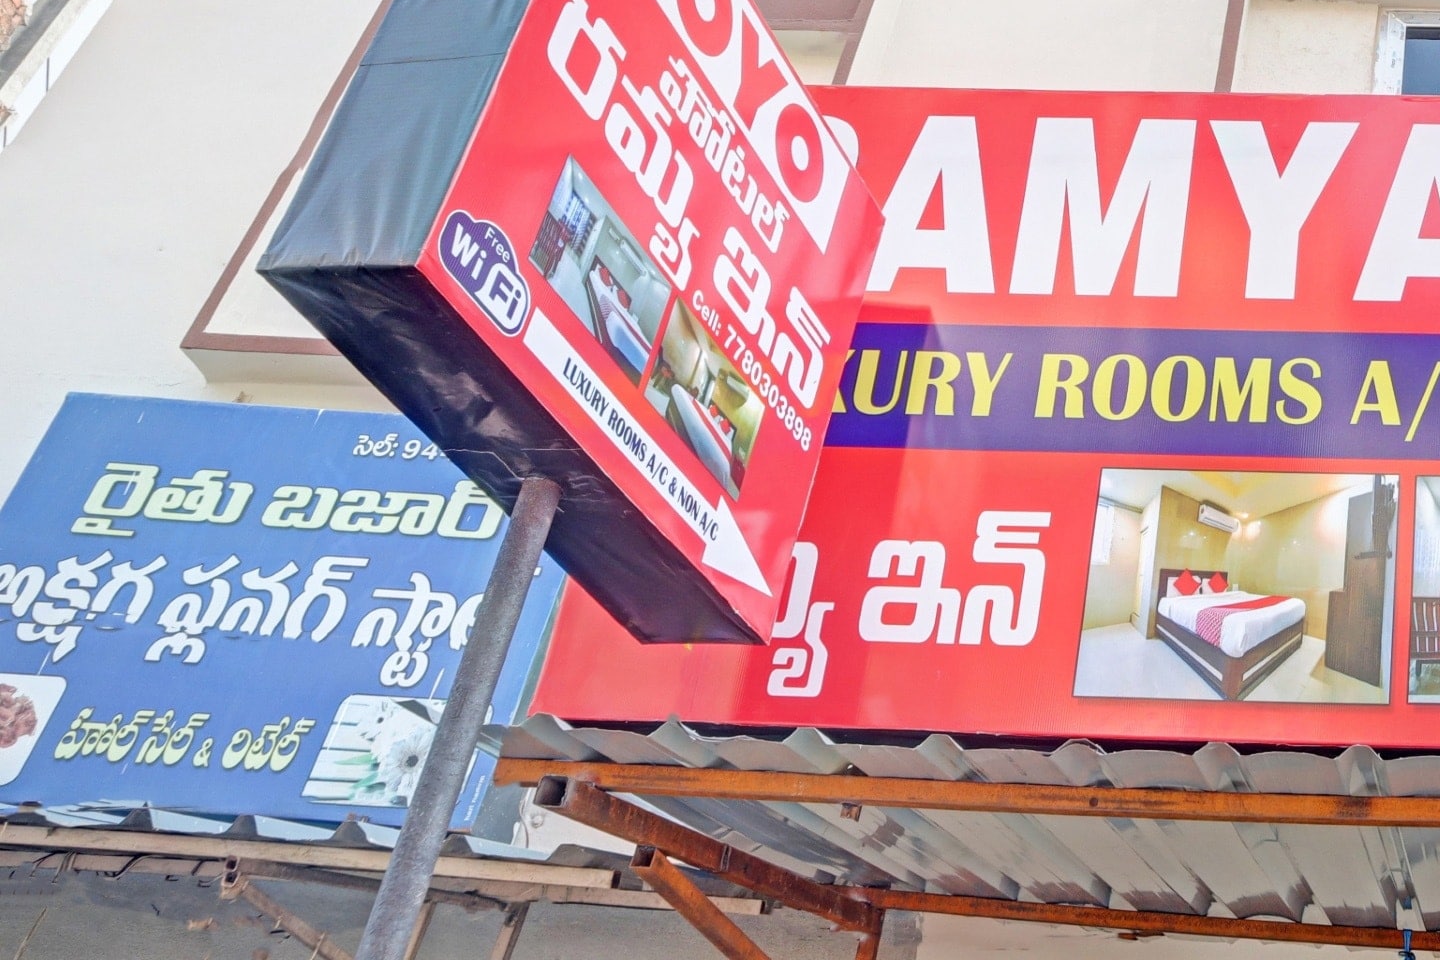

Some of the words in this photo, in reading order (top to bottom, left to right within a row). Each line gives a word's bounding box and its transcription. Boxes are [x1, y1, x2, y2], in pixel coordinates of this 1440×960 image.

[484, 226, 511, 263] Free
[713, 226, 835, 409] ఇన్
[692, 289, 722, 337] Cell:
[723, 323, 812, 452] 7780303898
[832, 349, 1014, 417] URY
[1034, 353, 1322, 423] ROOMS
[402, 439, 447, 460] 94
[563, 357, 610, 418] LUXURY
[607, 407, 648, 462] ROOMS
[646, 453, 669, 486] A/C
[668, 477, 679, 499] &
[678, 486, 700, 522] NON
[700, 508, 719, 542] A/C
[70, 462, 254, 537] రైతు
[859, 510, 1053, 646] ఇన్
[193, 738, 213, 767] &
